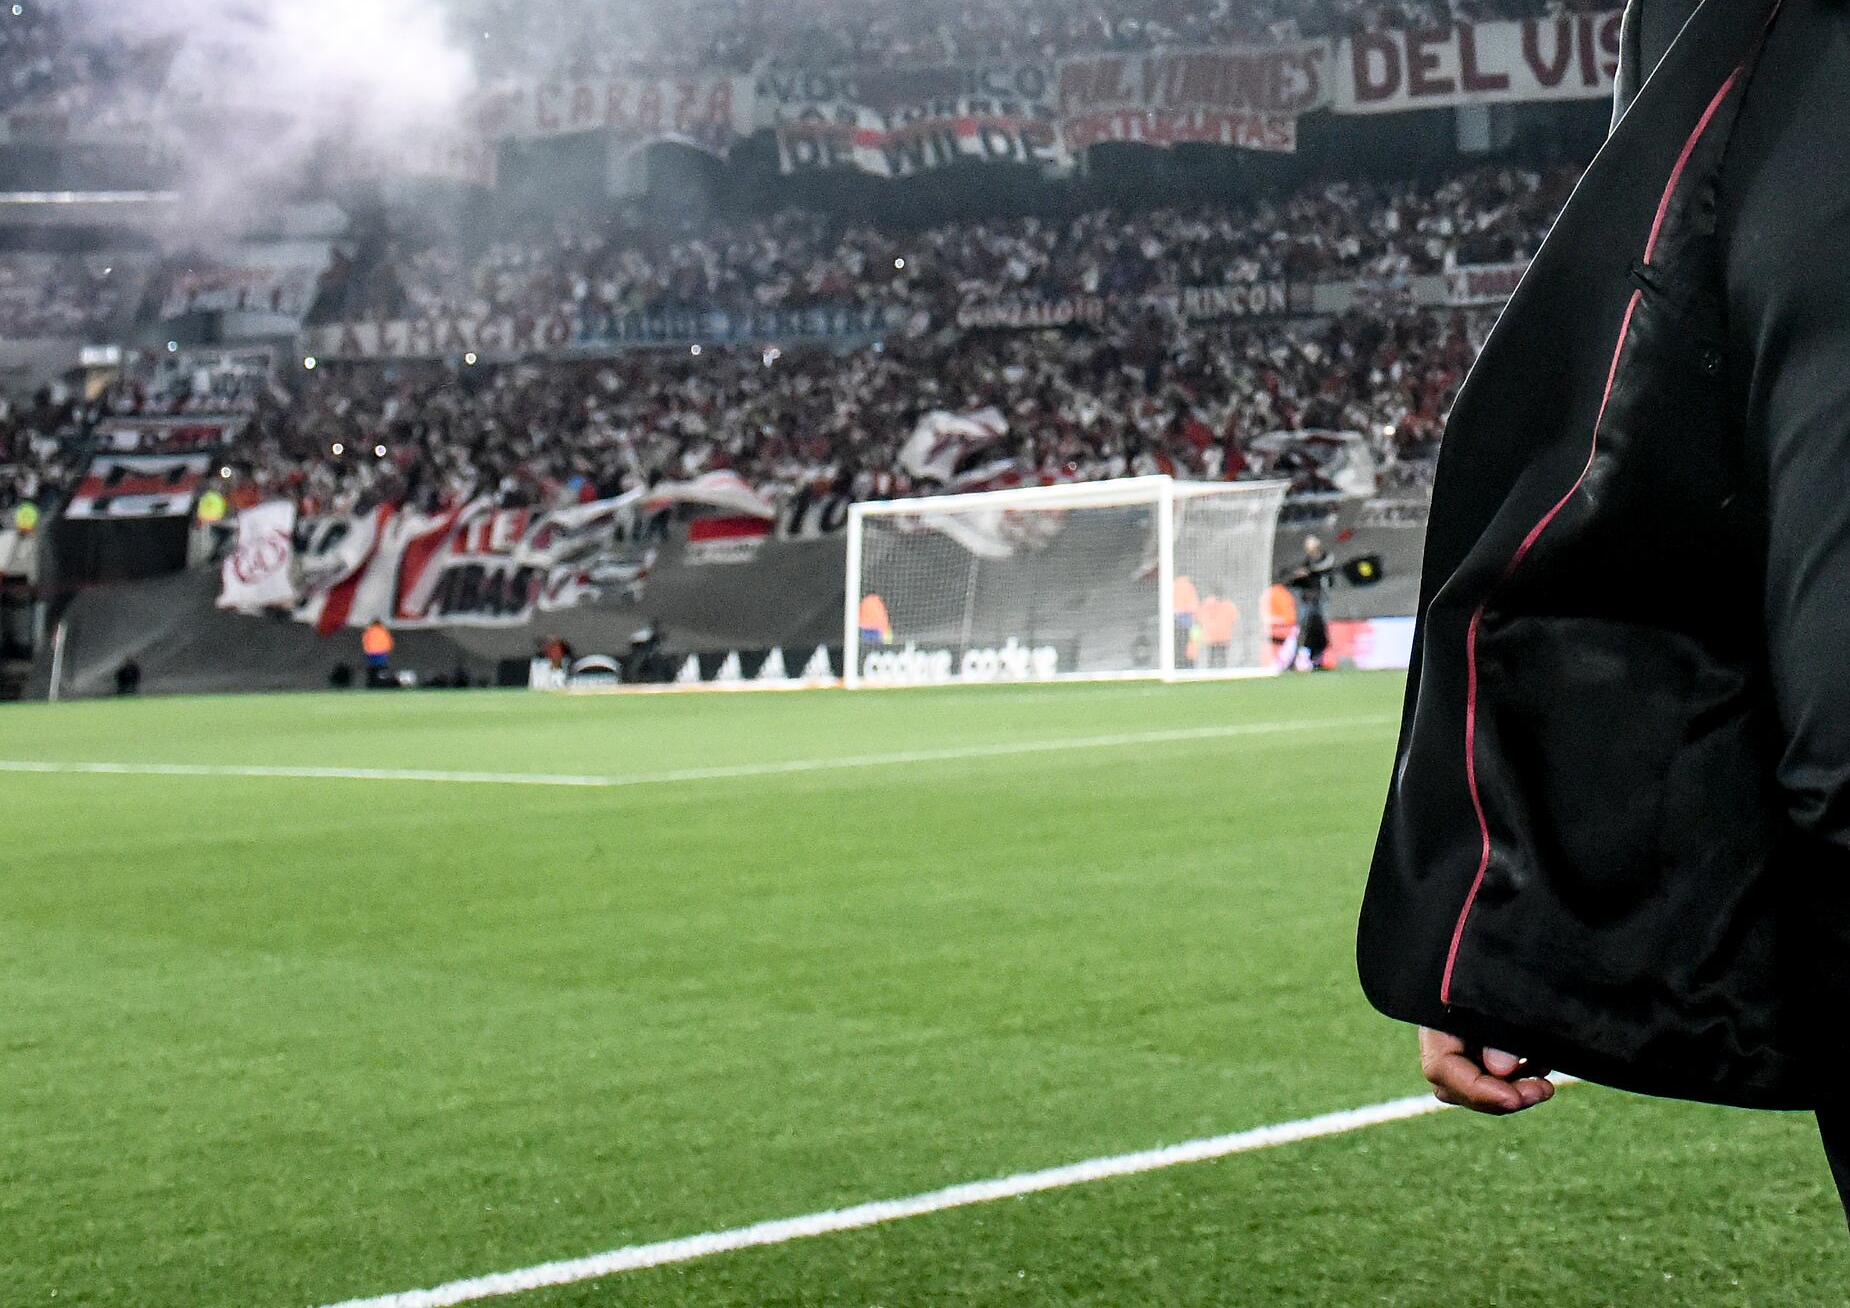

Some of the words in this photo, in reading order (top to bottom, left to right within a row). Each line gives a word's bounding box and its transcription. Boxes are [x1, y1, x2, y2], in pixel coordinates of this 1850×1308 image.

[1351, 22, 1510, 105] DEL
[863, 641, 951, 682] codere
[961, 637, 1056, 680] codere
